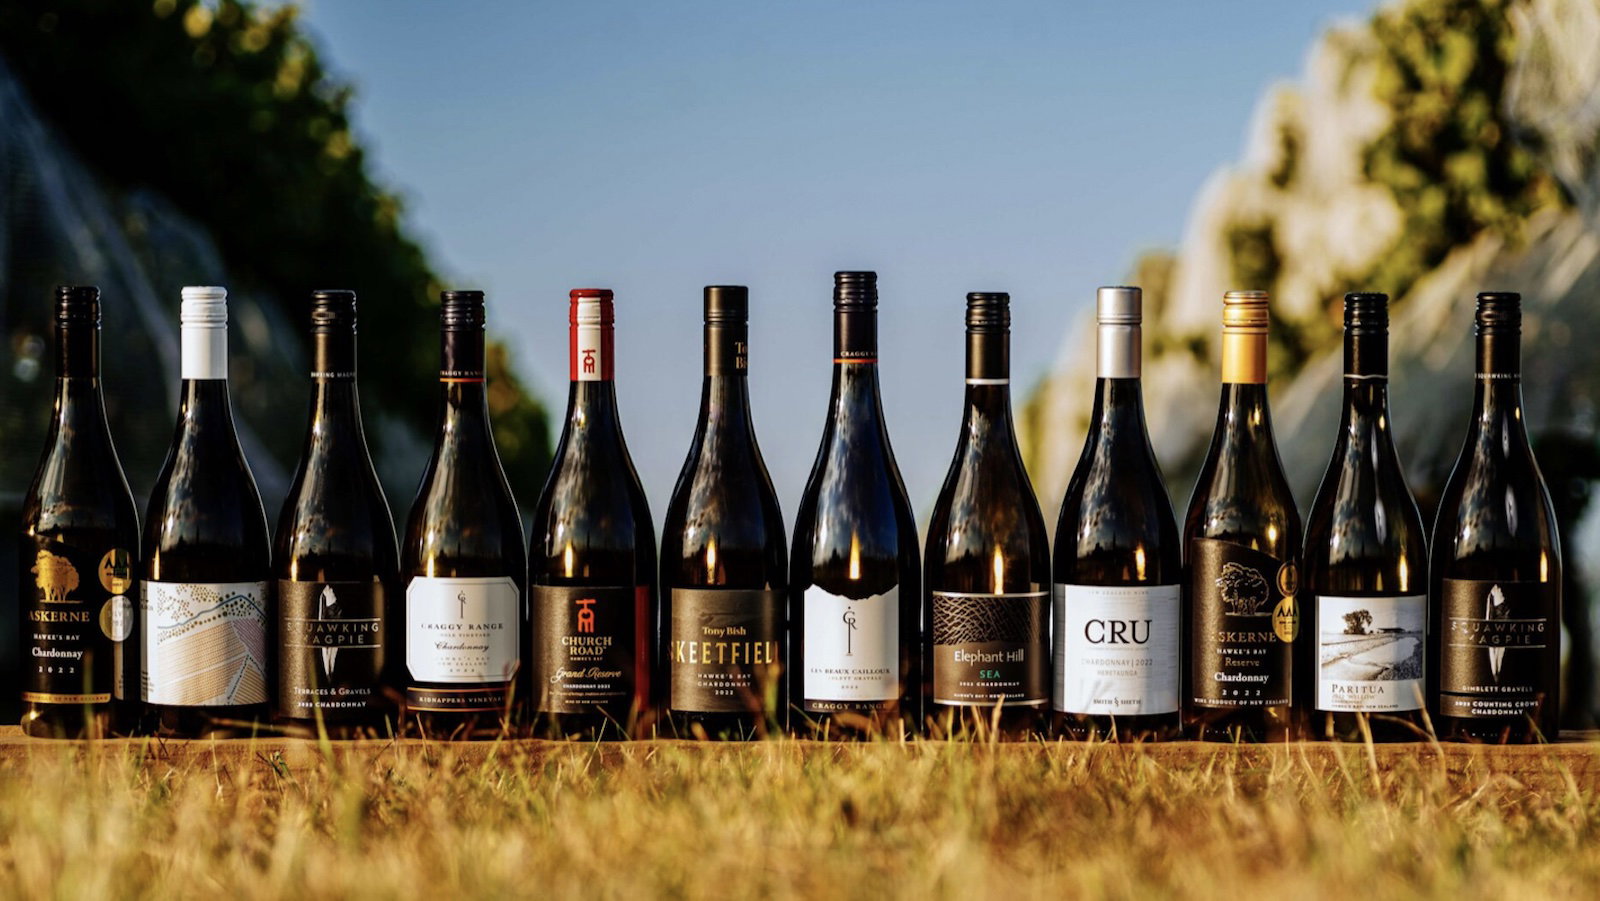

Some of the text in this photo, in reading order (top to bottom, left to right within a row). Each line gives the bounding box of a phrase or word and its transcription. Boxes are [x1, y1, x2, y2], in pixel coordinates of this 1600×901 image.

[468, 623, 504, 631] RANGE
[702, 626, 747, 638] Tony Bish
[1084, 619, 1152, 644] CRU
[66, 633, 80, 641] BAY
[304, 634, 364, 644] AGPIE
[561, 636, 612, 646] CHURCH
[1210, 631, 1277, 643] SKERNE
[435, 640, 490, 652] Chardonnay
[570, 646, 604, 656] ROAD
[32, 646, 83, 660] Chardonnay
[954, 648, 1024, 666] Elephant Hill
[1135, 658, 1153, 666] 2022
[1225, 658, 1260, 667] Reserve
[38, 666, 75, 674] 2022
[550, 666, 622, 684] Grand Reserve
[979, 670, 1001, 678] SEA
[1214, 672, 1269, 684] Chardonnay
[330, 687, 336, 696] &
[1332, 684, 1384, 694] PARITUA
[812, 702, 850, 710] CRAGGY
